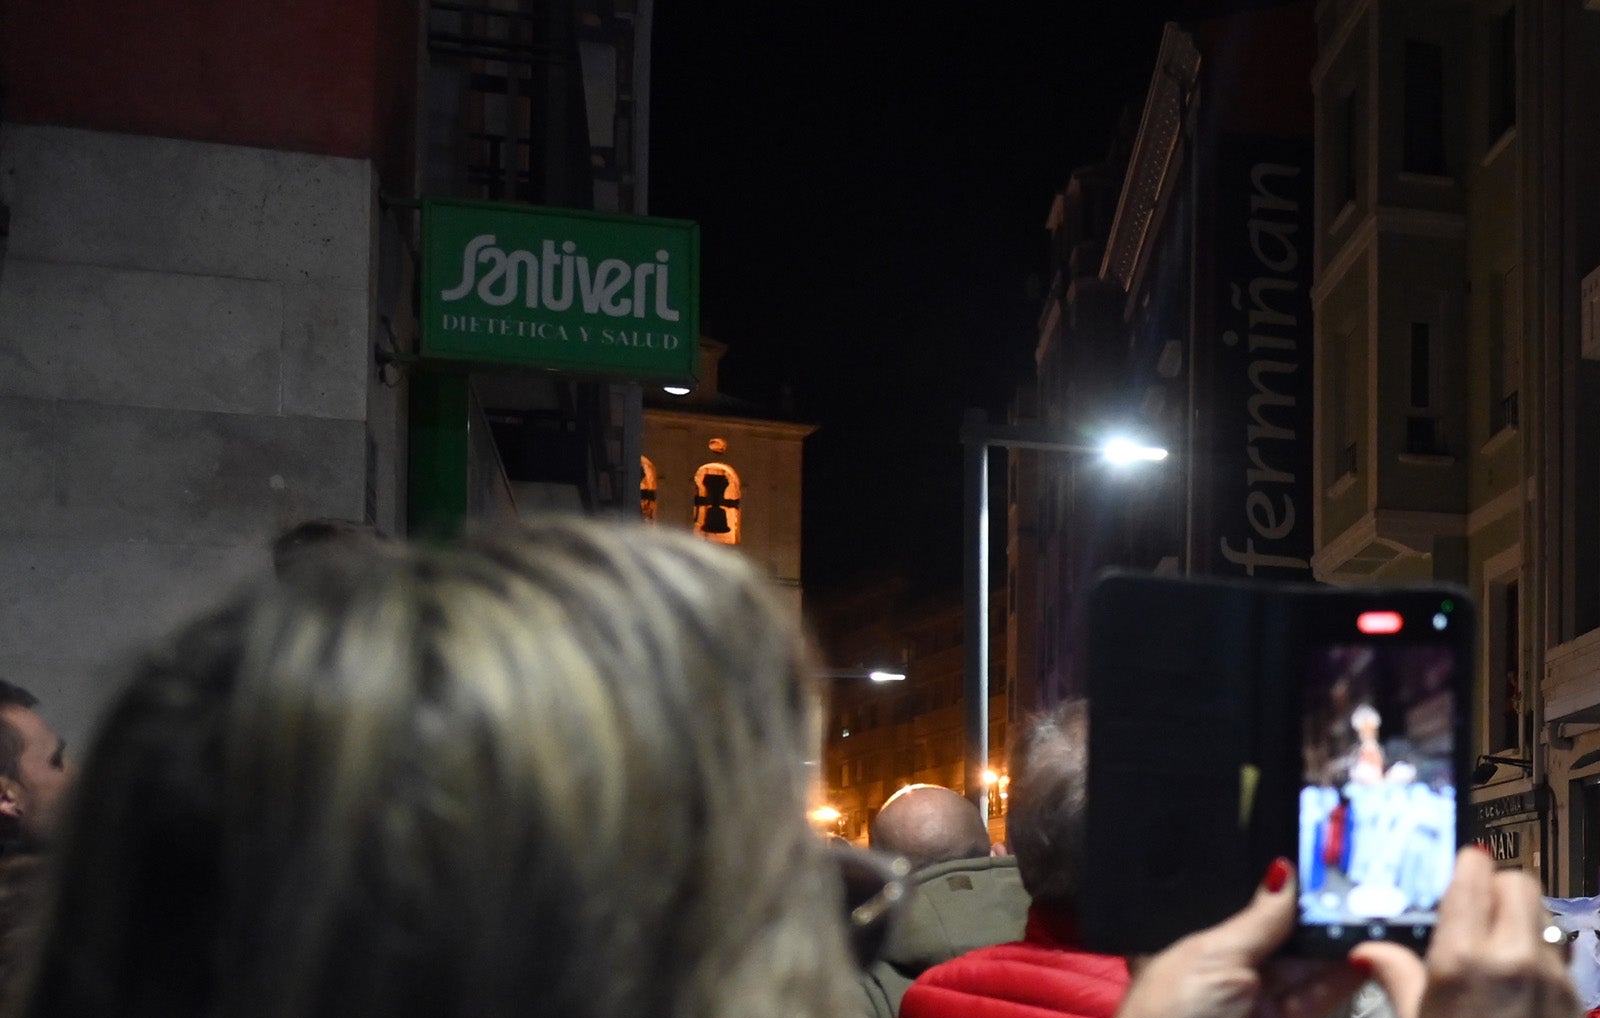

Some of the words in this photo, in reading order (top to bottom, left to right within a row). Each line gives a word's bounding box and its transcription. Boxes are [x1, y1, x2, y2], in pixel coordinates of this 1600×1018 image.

[441, 233, 679, 321] Santiveri
[579, 326, 593, 342] Y
[602, 328, 679, 350] SALUD
[1220, 161, 1311, 577] fermiñan
